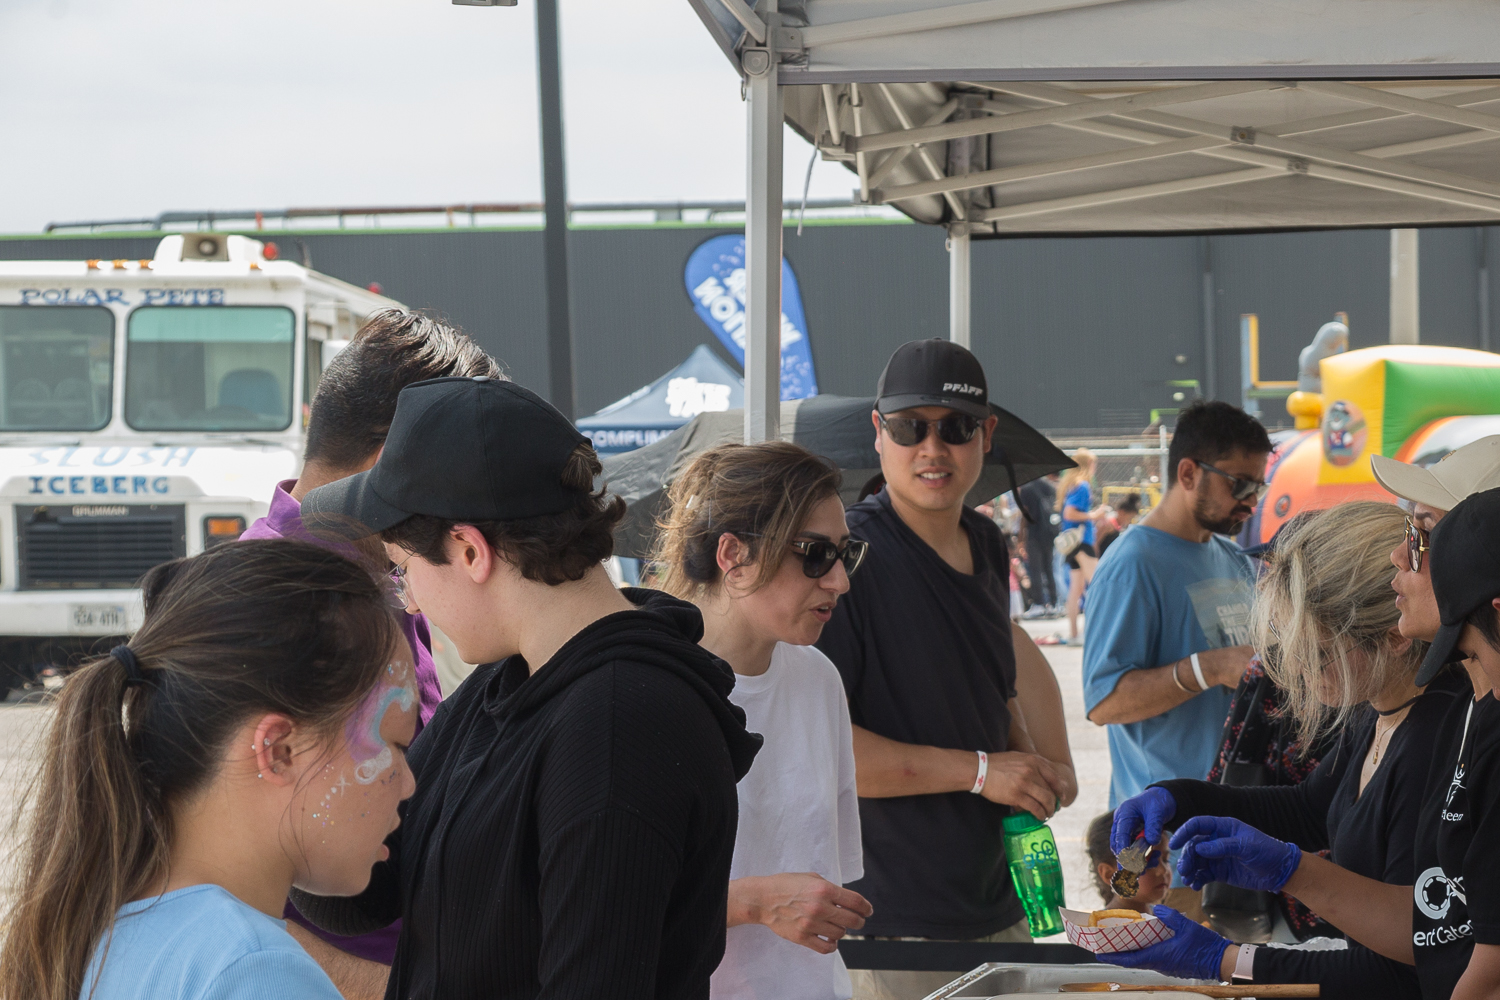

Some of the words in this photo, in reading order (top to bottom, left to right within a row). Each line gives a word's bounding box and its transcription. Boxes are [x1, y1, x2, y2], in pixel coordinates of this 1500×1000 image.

[19, 288, 130, 306] POLAR
[138, 288, 225, 306] PETE
[942, 382, 984, 396] PFAFF
[21, 446, 200, 468] SLUSH
[28, 476, 170, 495] ICEBERG
[72, 505, 129, 516] GRUMMAN
